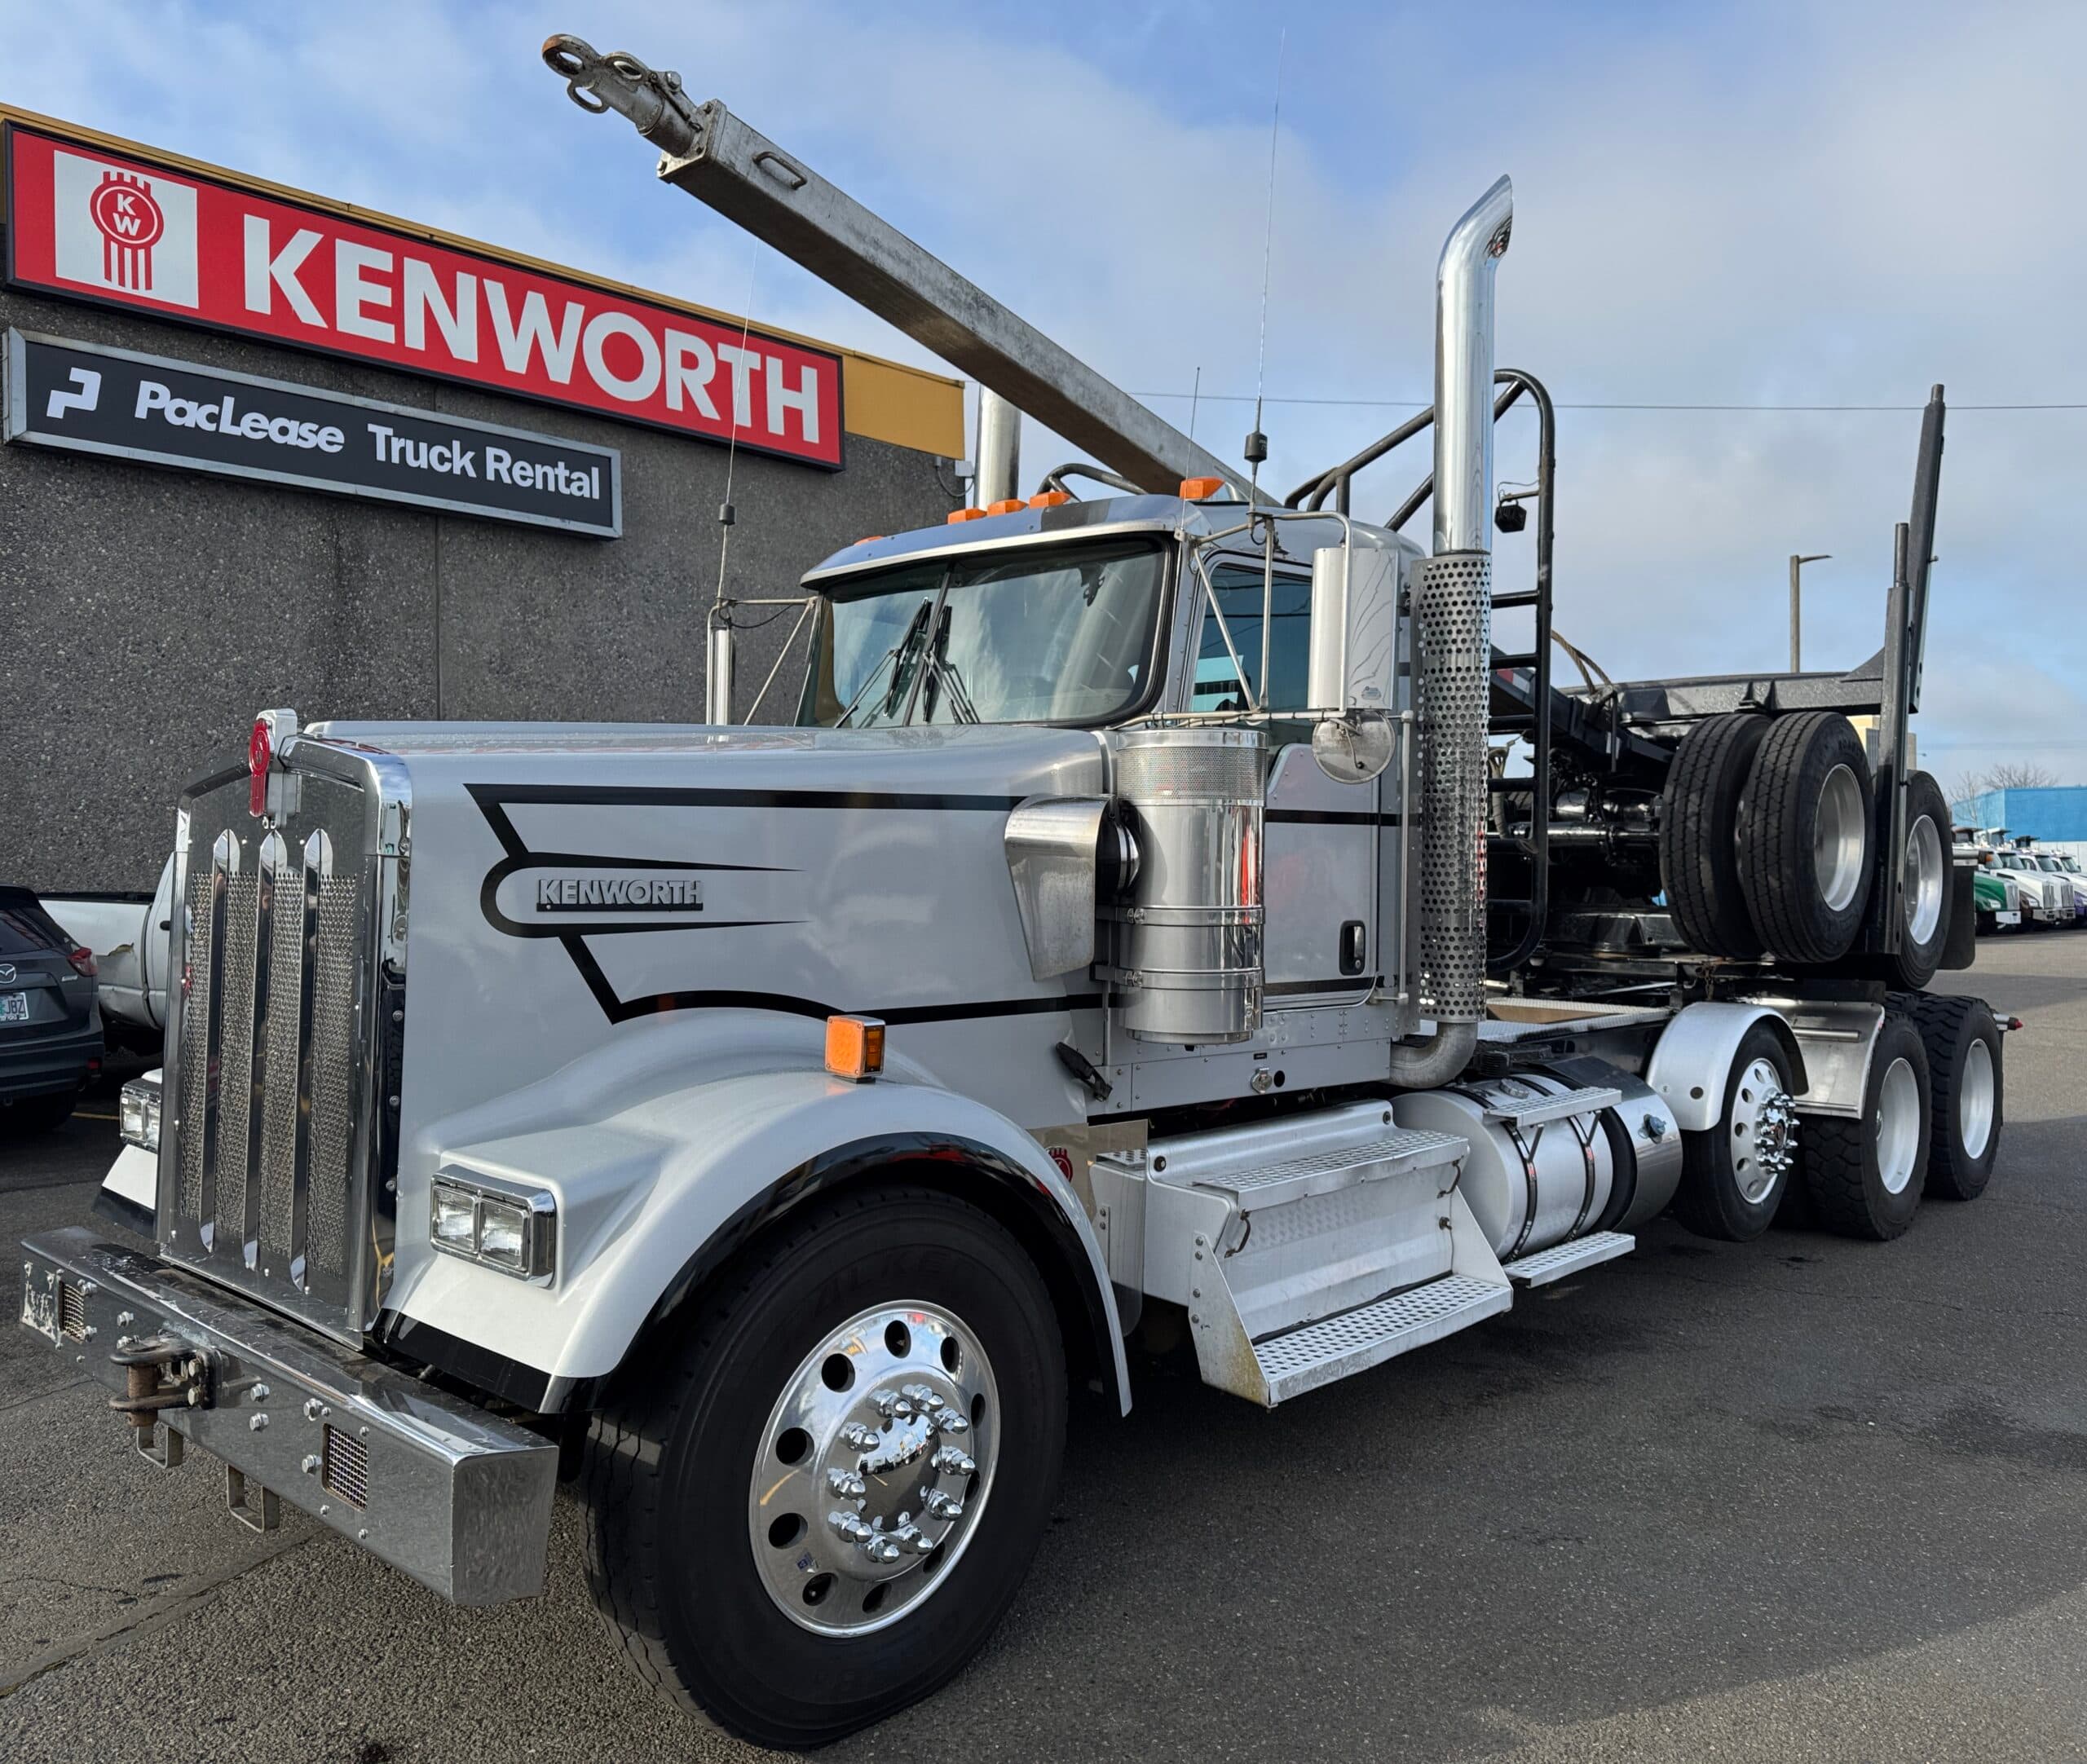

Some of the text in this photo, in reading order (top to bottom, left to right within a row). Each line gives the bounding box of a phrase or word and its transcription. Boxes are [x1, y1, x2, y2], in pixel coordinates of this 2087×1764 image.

[244, 213, 820, 444] KENWORTH
[134, 379, 600, 500] PacLease Truck Rental
[539, 880, 703, 905] KENWORTH
